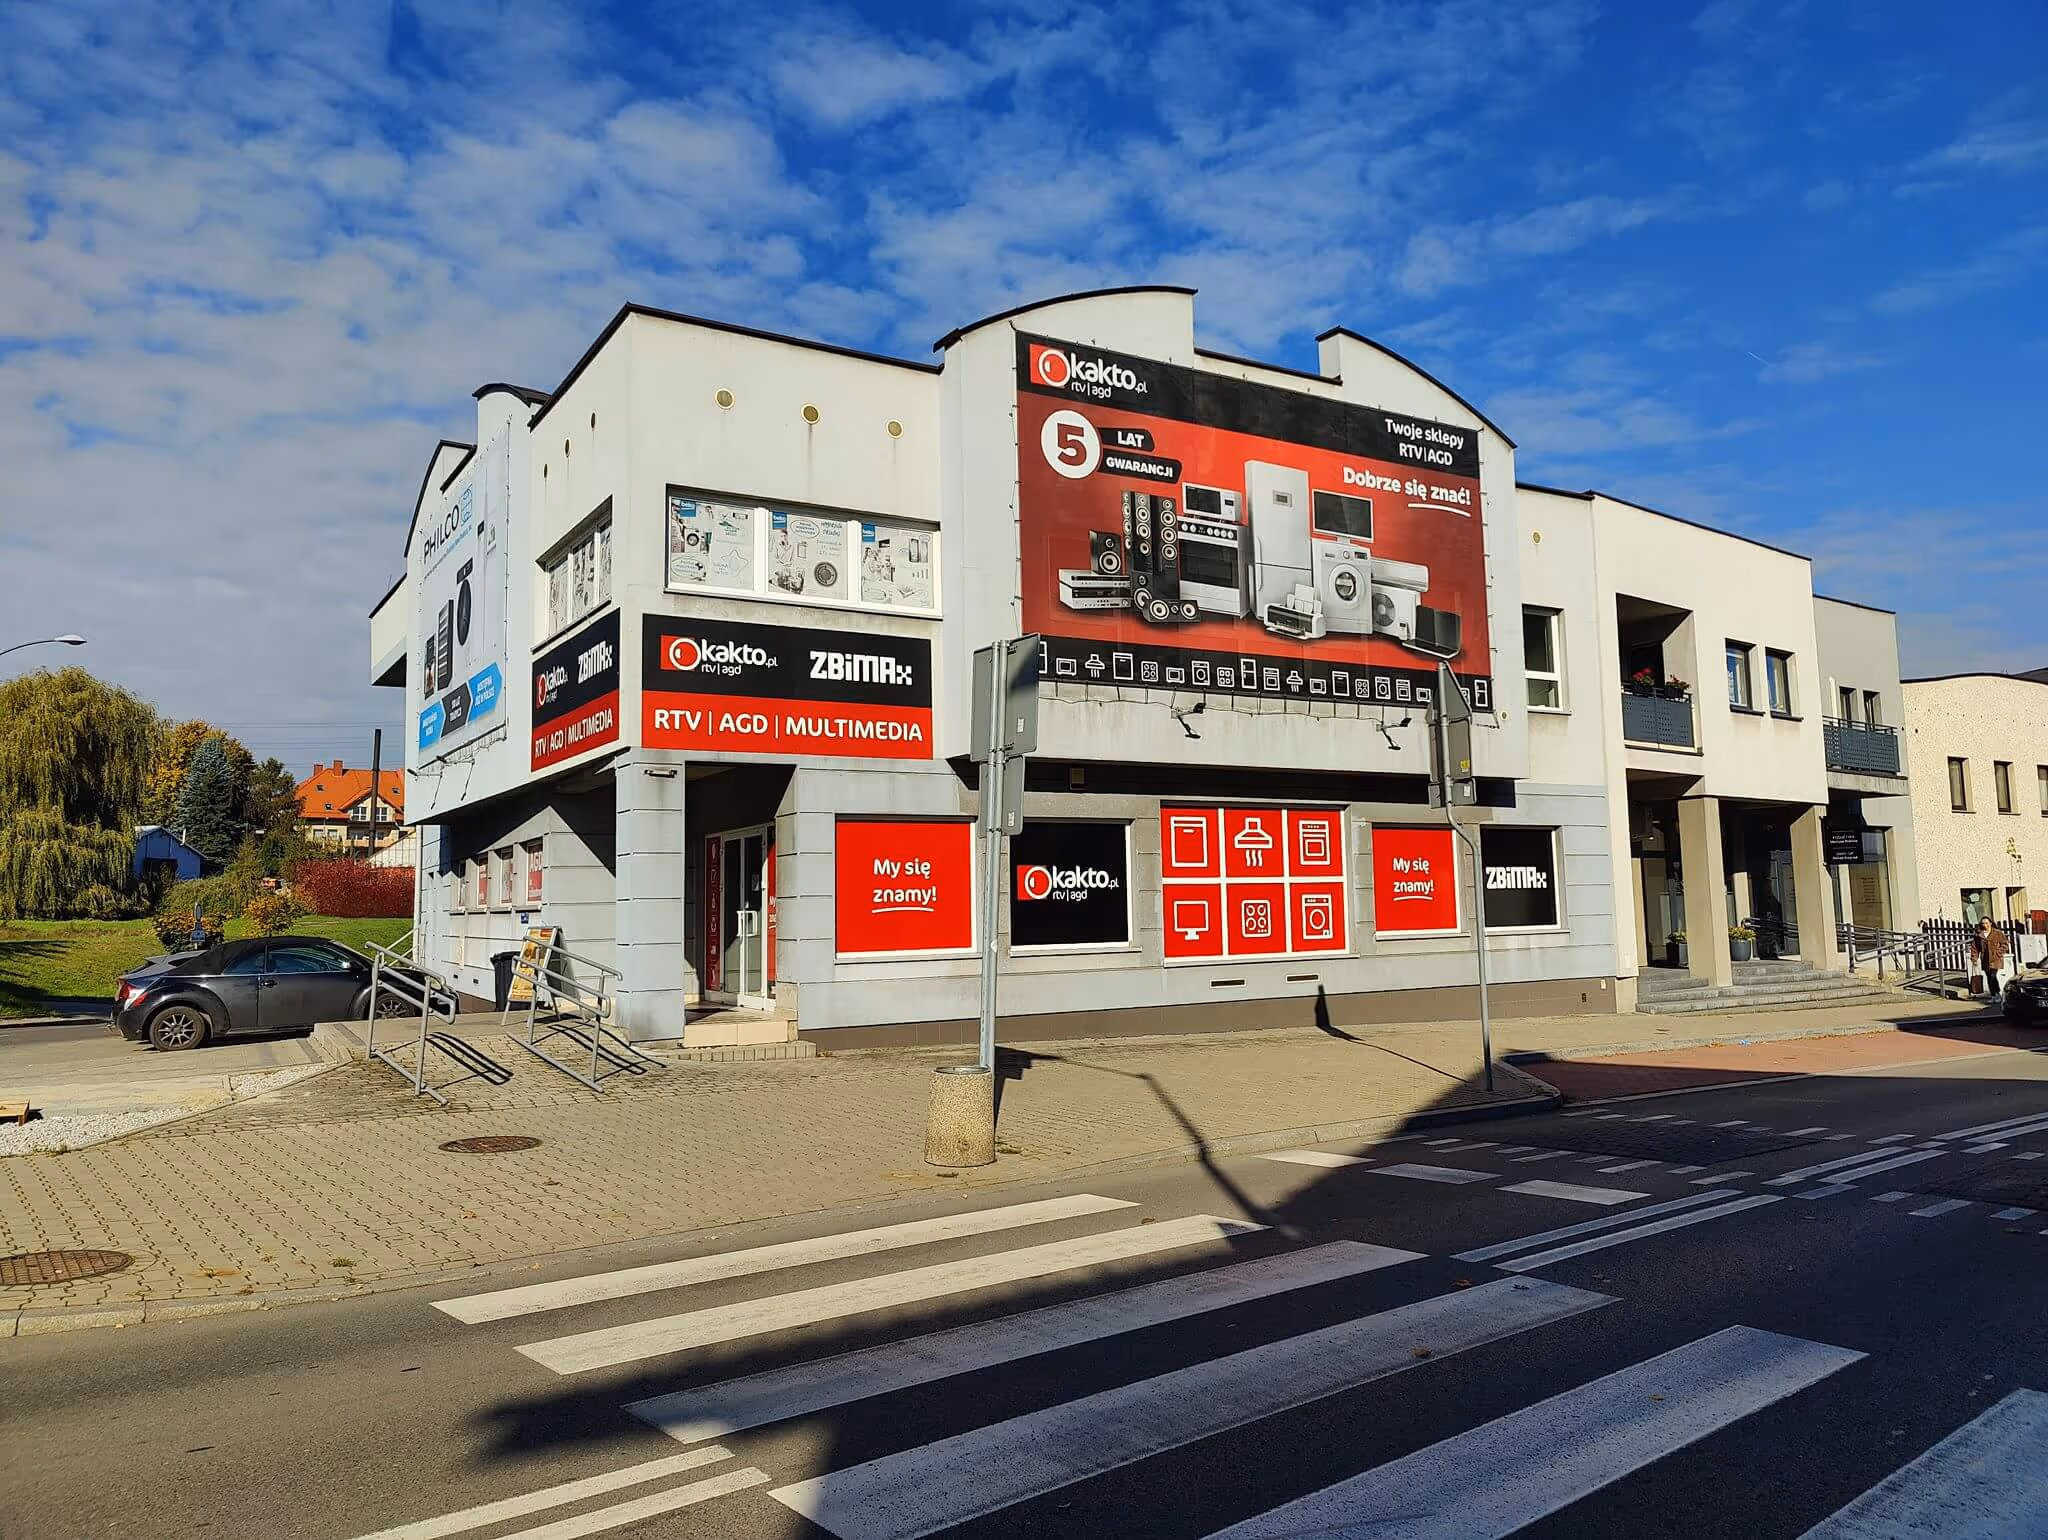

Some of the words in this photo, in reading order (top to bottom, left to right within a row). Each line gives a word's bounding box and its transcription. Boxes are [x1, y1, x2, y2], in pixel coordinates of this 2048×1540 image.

[1057, 422, 1088, 467] 5
[1117, 431, 1144, 448] LAT
[1385, 418, 1423, 440] Twoje
[1425, 427, 1464, 450] sklepy
[1106, 457, 1173, 478] GWARANCJI
[1343, 466, 1401, 493] Dobrze
[1405, 479, 1427, 501] się
[1430, 487, 1472, 506] znać!
[424, 504, 459, 565] PHILCO
[535, 737, 547, 758] RTV
[550, 729, 564, 753] AGD
[568, 707, 614, 745] MULTIMEDIA
[654, 709, 702, 731] RTV
[719, 712, 769, 734] AGD
[785, 716, 923, 742] MULTIMEDIA
[873, 858, 901, 879] My
[904, 858, 931, 880] się
[1393, 857, 1411, 874] My
[1412, 857, 1430, 874] się
[872, 885, 937, 906] znamy!
[1393, 879, 1434, 896] znamy!
